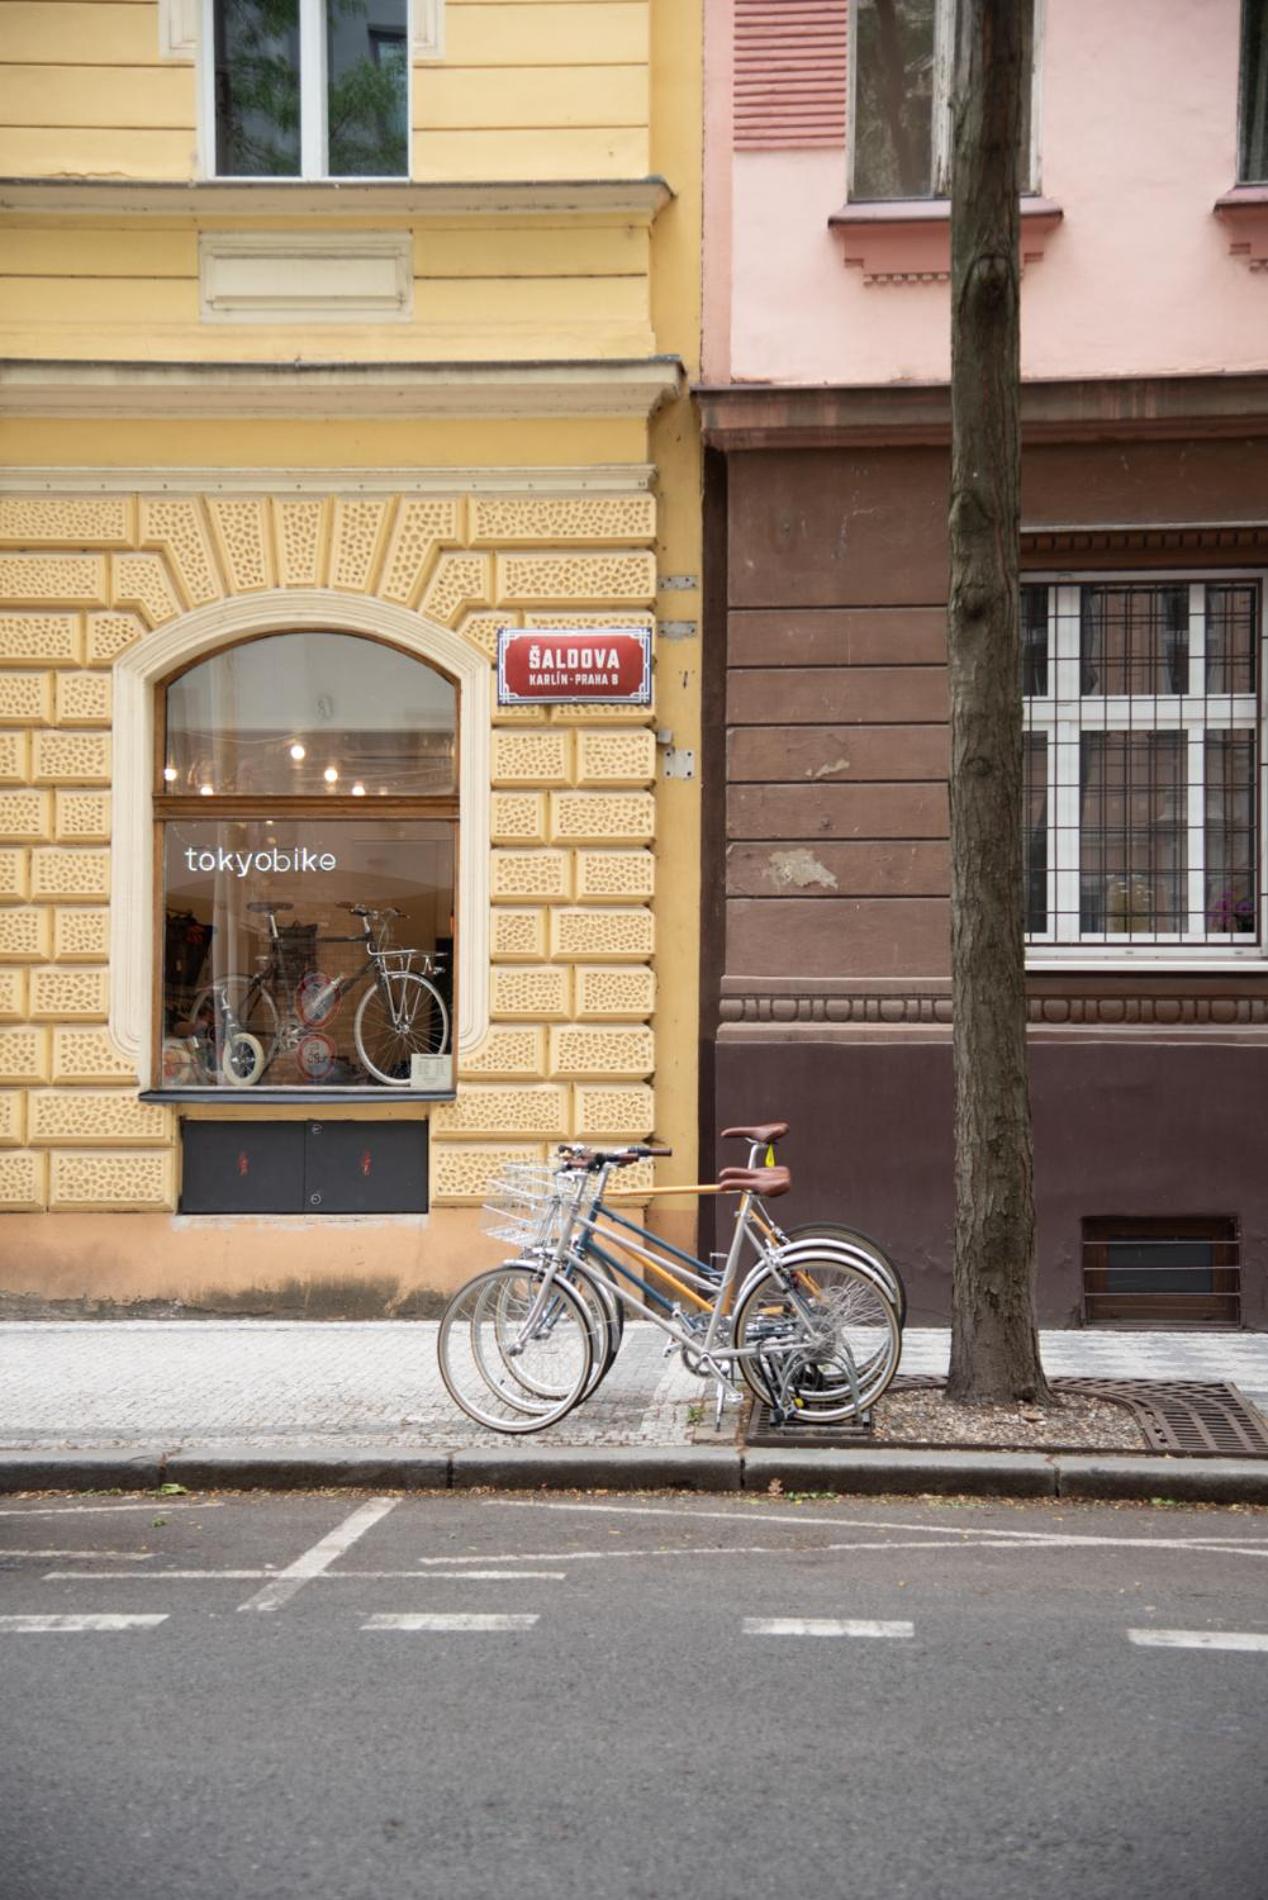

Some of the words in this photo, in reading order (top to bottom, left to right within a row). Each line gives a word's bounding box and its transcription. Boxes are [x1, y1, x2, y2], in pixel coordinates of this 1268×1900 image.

[529, 644, 620, 669] ŠALDOVA
[529, 670, 568, 686] KARLÍN
[575, 673, 609, 686] PRAHA
[184, 847, 337, 878] tokyobike
